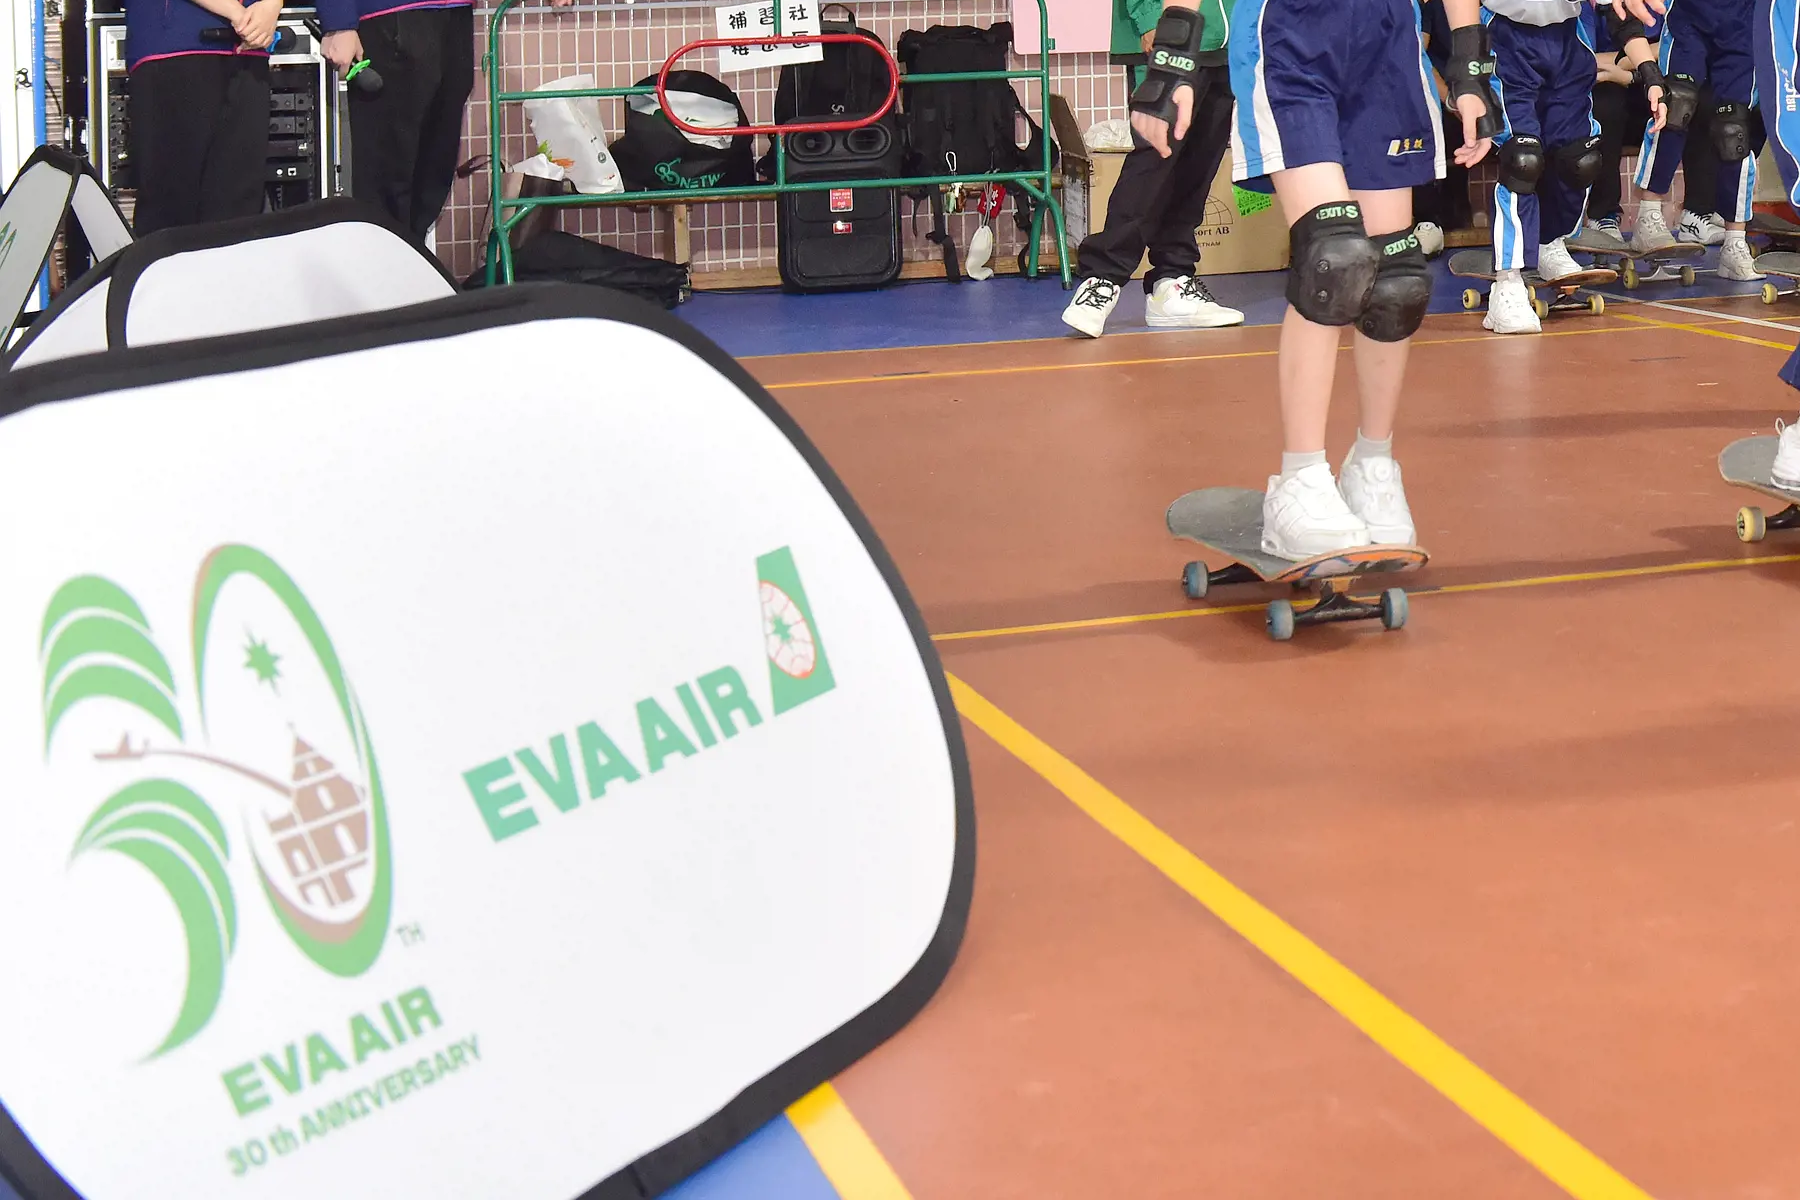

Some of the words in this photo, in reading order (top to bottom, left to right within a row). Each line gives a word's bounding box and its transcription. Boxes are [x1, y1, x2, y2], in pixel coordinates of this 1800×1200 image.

[729, 4, 808, 30] 補習社
[1216, 227, 1230, 235] AB
[298, 1033, 482, 1143] ANNIVERSARY
